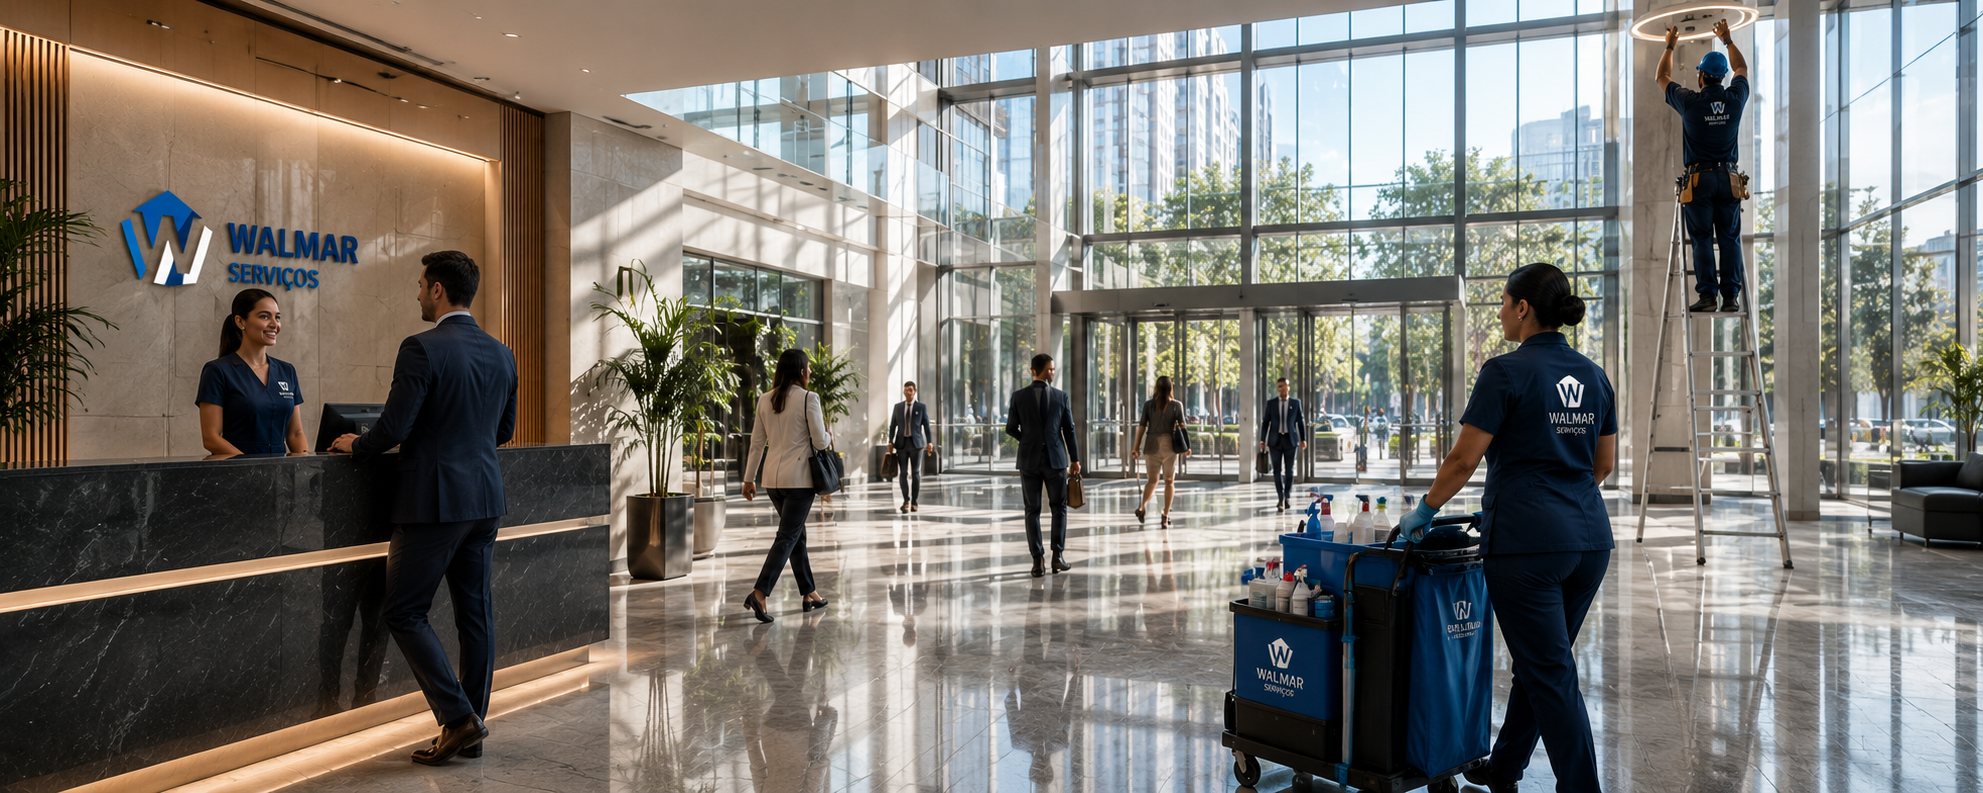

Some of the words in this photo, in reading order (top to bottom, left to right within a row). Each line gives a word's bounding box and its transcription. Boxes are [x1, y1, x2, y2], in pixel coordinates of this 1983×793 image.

[227, 222, 359, 264] WALMAR
[228, 262, 320, 291] SERVIÇOS
[1548, 412, 1595, 425] WALMAR
[1256, 667, 1304, 690] WALMAR
